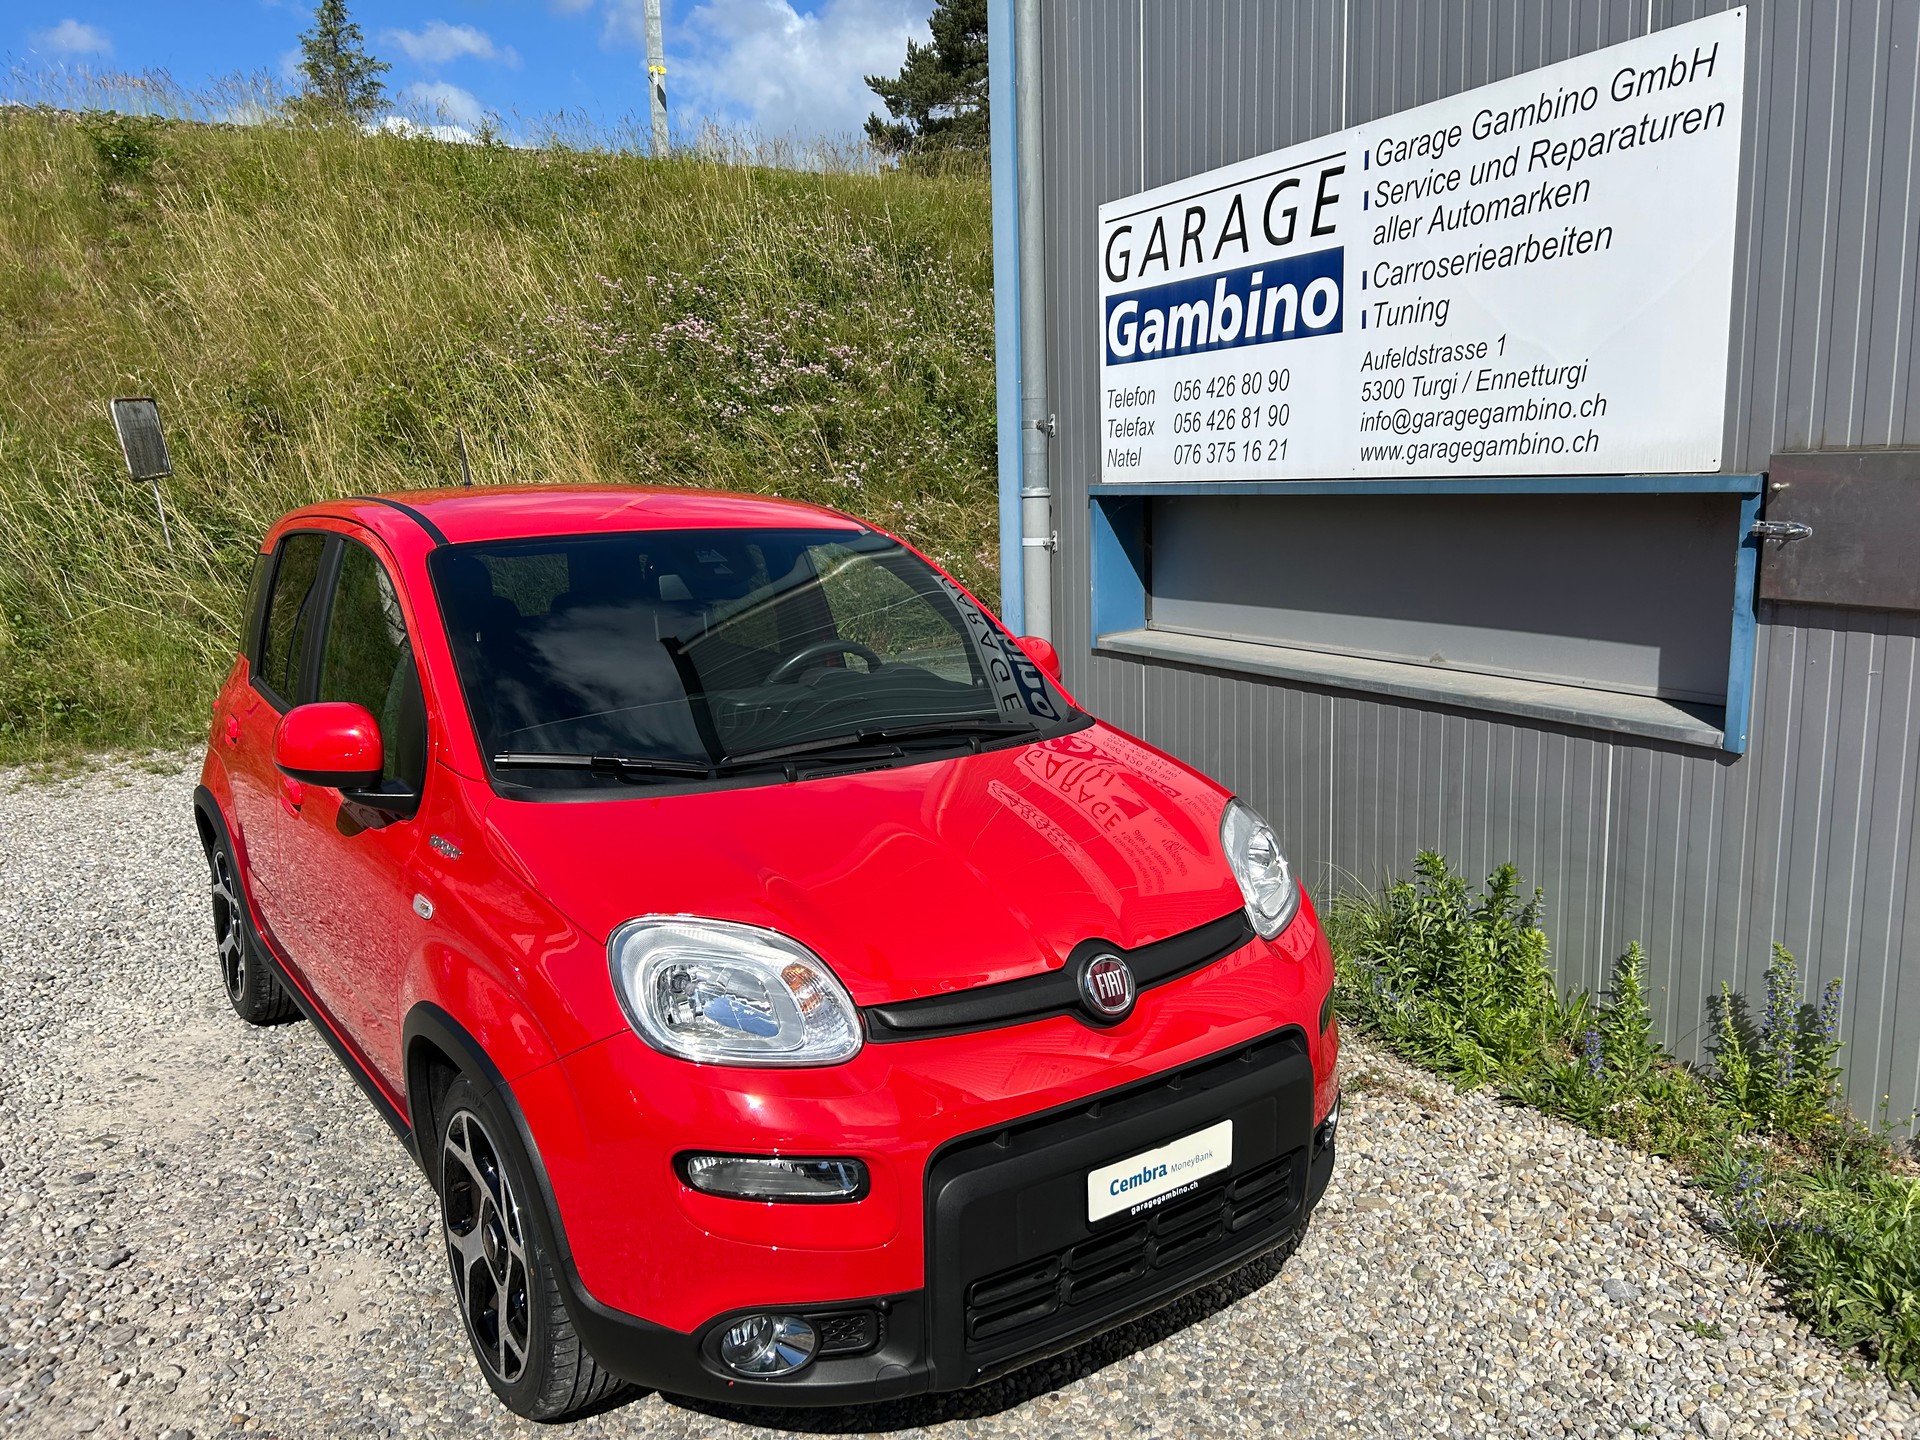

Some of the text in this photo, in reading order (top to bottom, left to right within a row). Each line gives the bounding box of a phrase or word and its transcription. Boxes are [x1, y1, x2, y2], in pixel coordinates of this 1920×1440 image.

[1375, 41, 1719, 167] Garage Gambino GmbH
[1374, 102, 1725, 209] Service und Reparaturen
[1105, 164, 1346, 283] GARAGE
[1373, 179, 1591, 246] aller Automarken
[1373, 226, 1613, 289] Carroseriearbeiten
[1107, 270, 1341, 358] Gambino
[1373, 298, 1451, 329] Tuning
[1360, 333, 1507, 373] Aufeldstrasse 1
[1107, 368, 1290, 409] Telefon 056 426 80 90
[1361, 359, 1588, 403] 5300 Turgi / Ennetturgi
[1107, 403, 1290, 439] Telefax 056 426 81 90
[1360, 392, 1607, 435] info@garagegambino.ch
[1107, 438, 1288, 468] Natel 076 375 16 21
[1360, 428, 1599, 466] www.garagegambino.ch
[1095, 969, 1124, 999] FIAT
[1109, 1149, 1214, 1196] Cembra MoneyBank
[1130, 1180, 1199, 1215] garagegambino.ch
